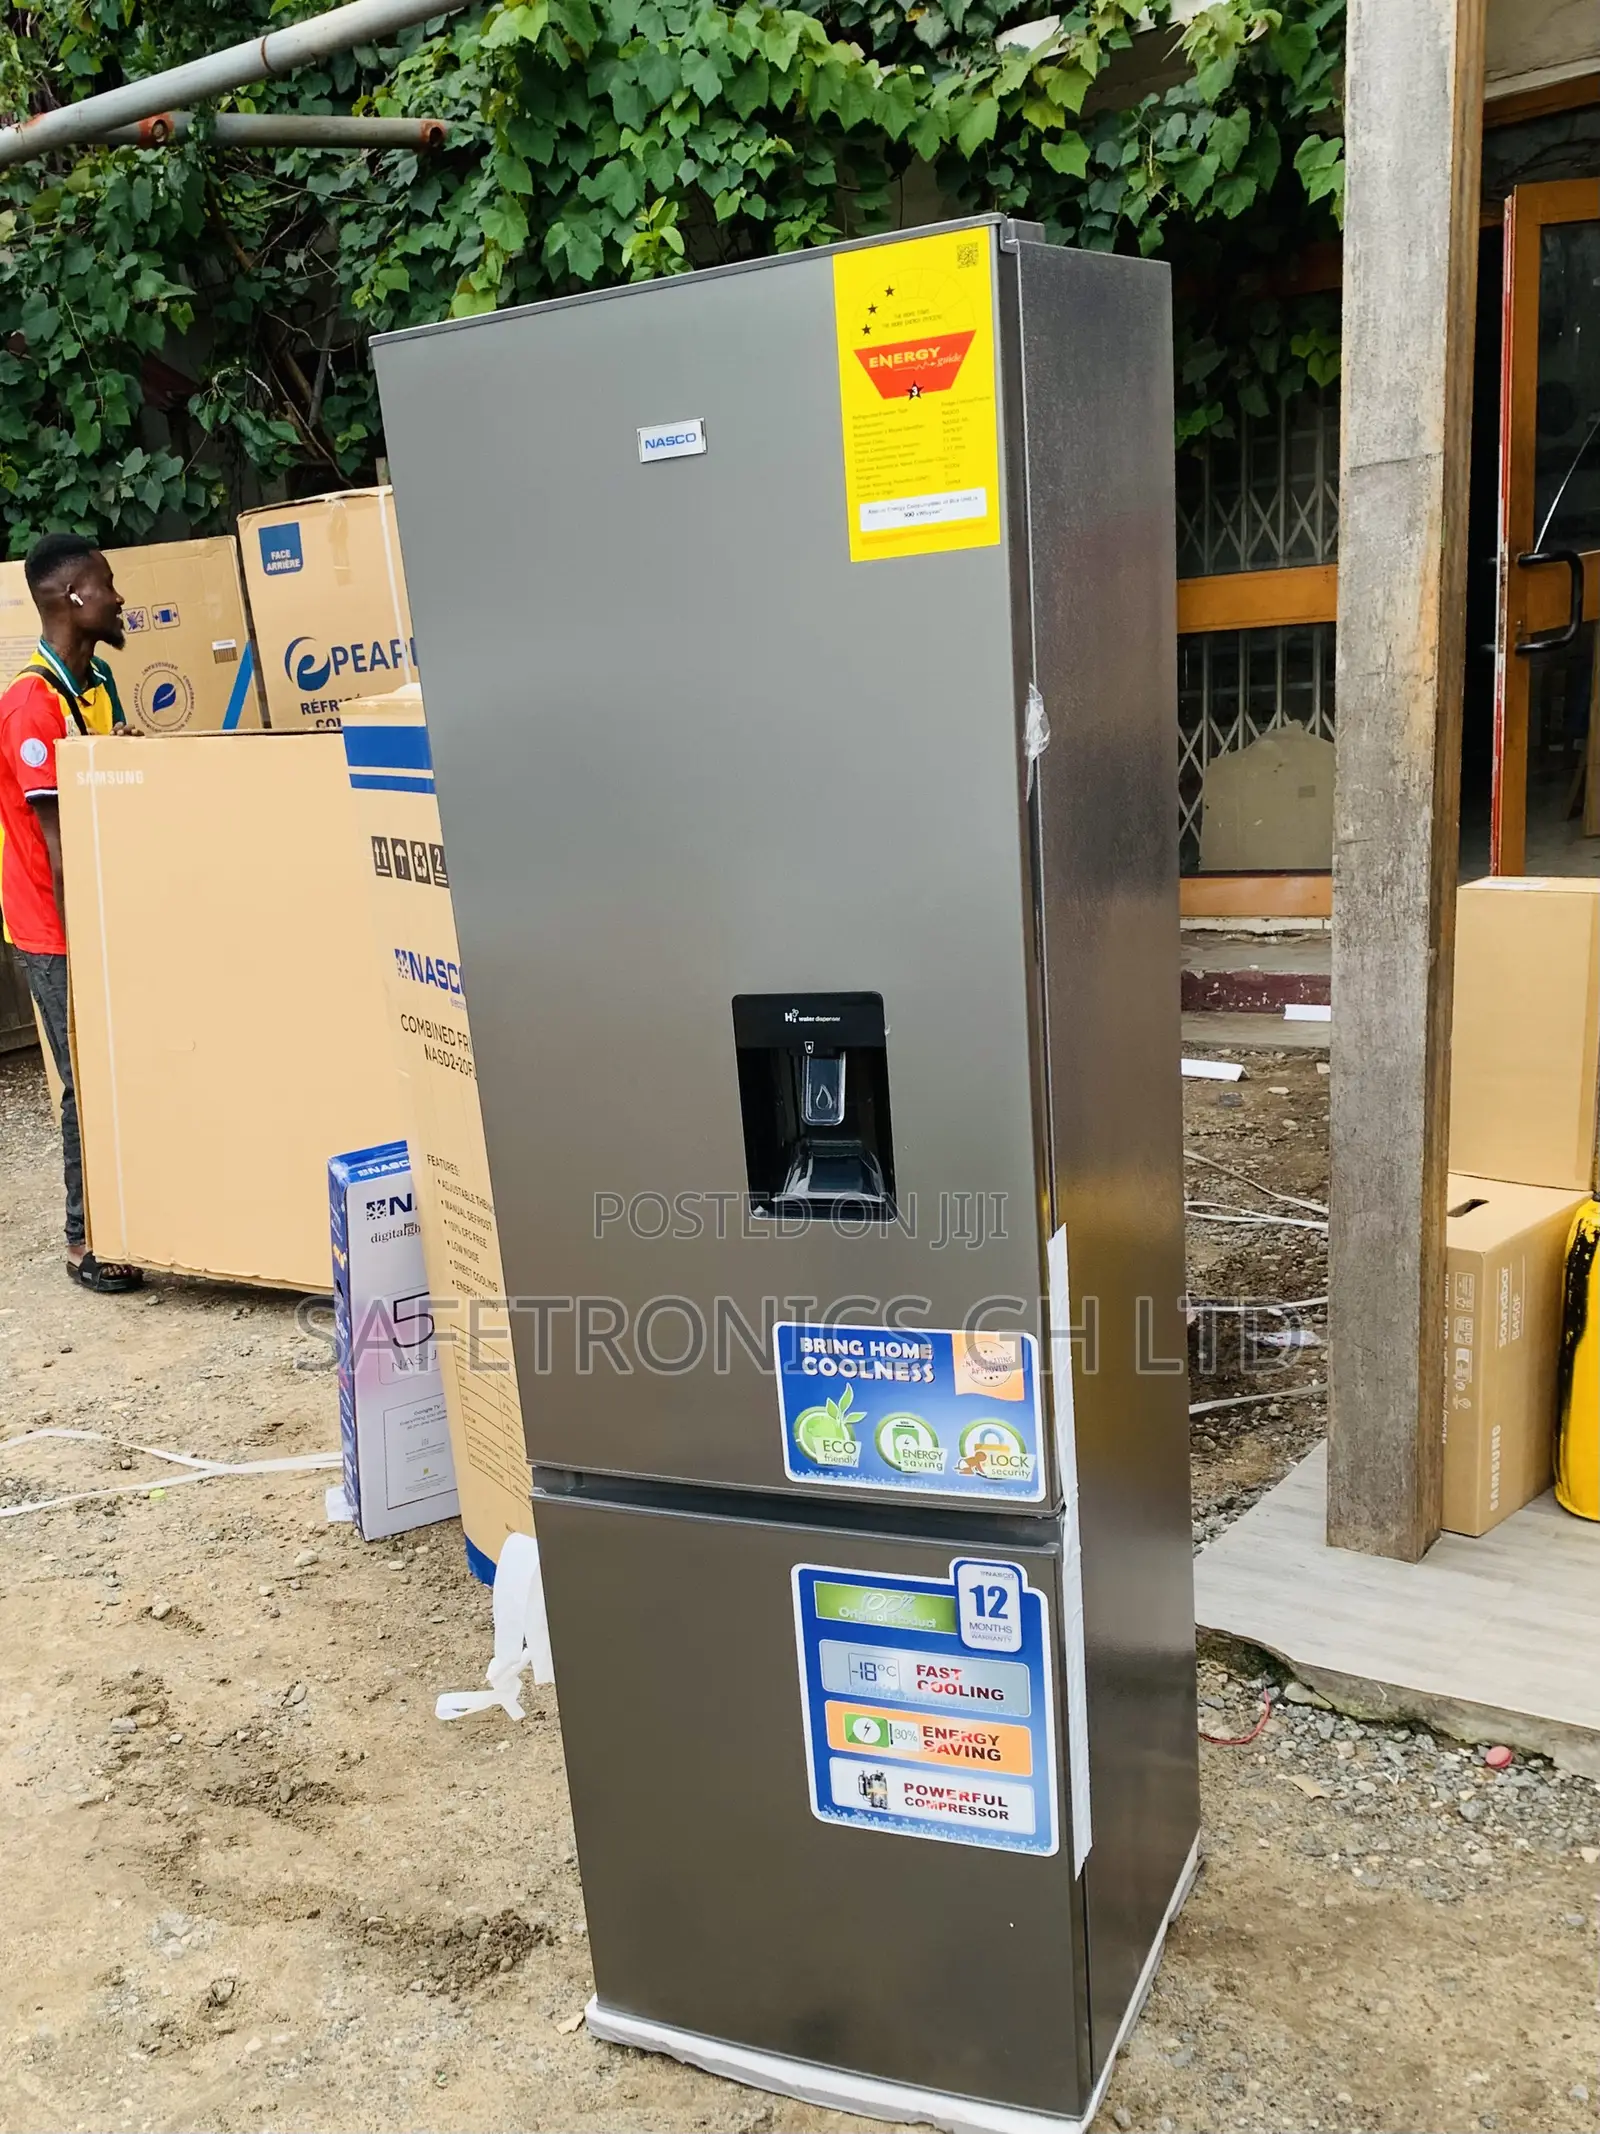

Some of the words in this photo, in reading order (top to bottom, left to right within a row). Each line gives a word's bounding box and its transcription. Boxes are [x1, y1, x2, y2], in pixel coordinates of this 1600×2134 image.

[869, 346, 941, 369] ENERGY
[936, 352, 963, 368] guide
[911, 386, 918, 396] 3
[645, 432, 697, 450] NASCO
[270, 549, 291, 561] FACE
[76, 770, 145, 785] SAMSUNG
[400, 1013, 457, 1048] COMBINED
[473, 1269, 498, 1293] COOLING
[1499, 1267, 1509, 1349] Soundbar
[800, 1336, 865, 1357] BRING
[869, 1339, 934, 1360] HOME
[801, 1356, 936, 1384] COOLNESS
[823, 1439, 857, 1454] ECO
[902, 1449, 943, 1462] ENERGY
[824, 1453, 858, 1466] friendly
[903, 1459, 944, 1472] saving
[990, 1454, 1029, 1468] LOCK
[1490, 1424, 1501, 1512] SAMSUNG
[991, 1467, 1031, 1479] security
[969, 1584, 1009, 1620] 12
[969, 1622, 1013, 1634] MONTHS
[916, 1664, 962, 1681] FAST
[917, 1680, 1004, 1702] COOLING
[894, 1728, 918, 1742] 30%
[922, 1725, 1000, 1747] ENERGY
[923, 1740, 1002, 1762] SAVING
[904, 1782, 1009, 1808] POWERFUL
[904, 1796, 1010, 1821] COMPRESSOR
